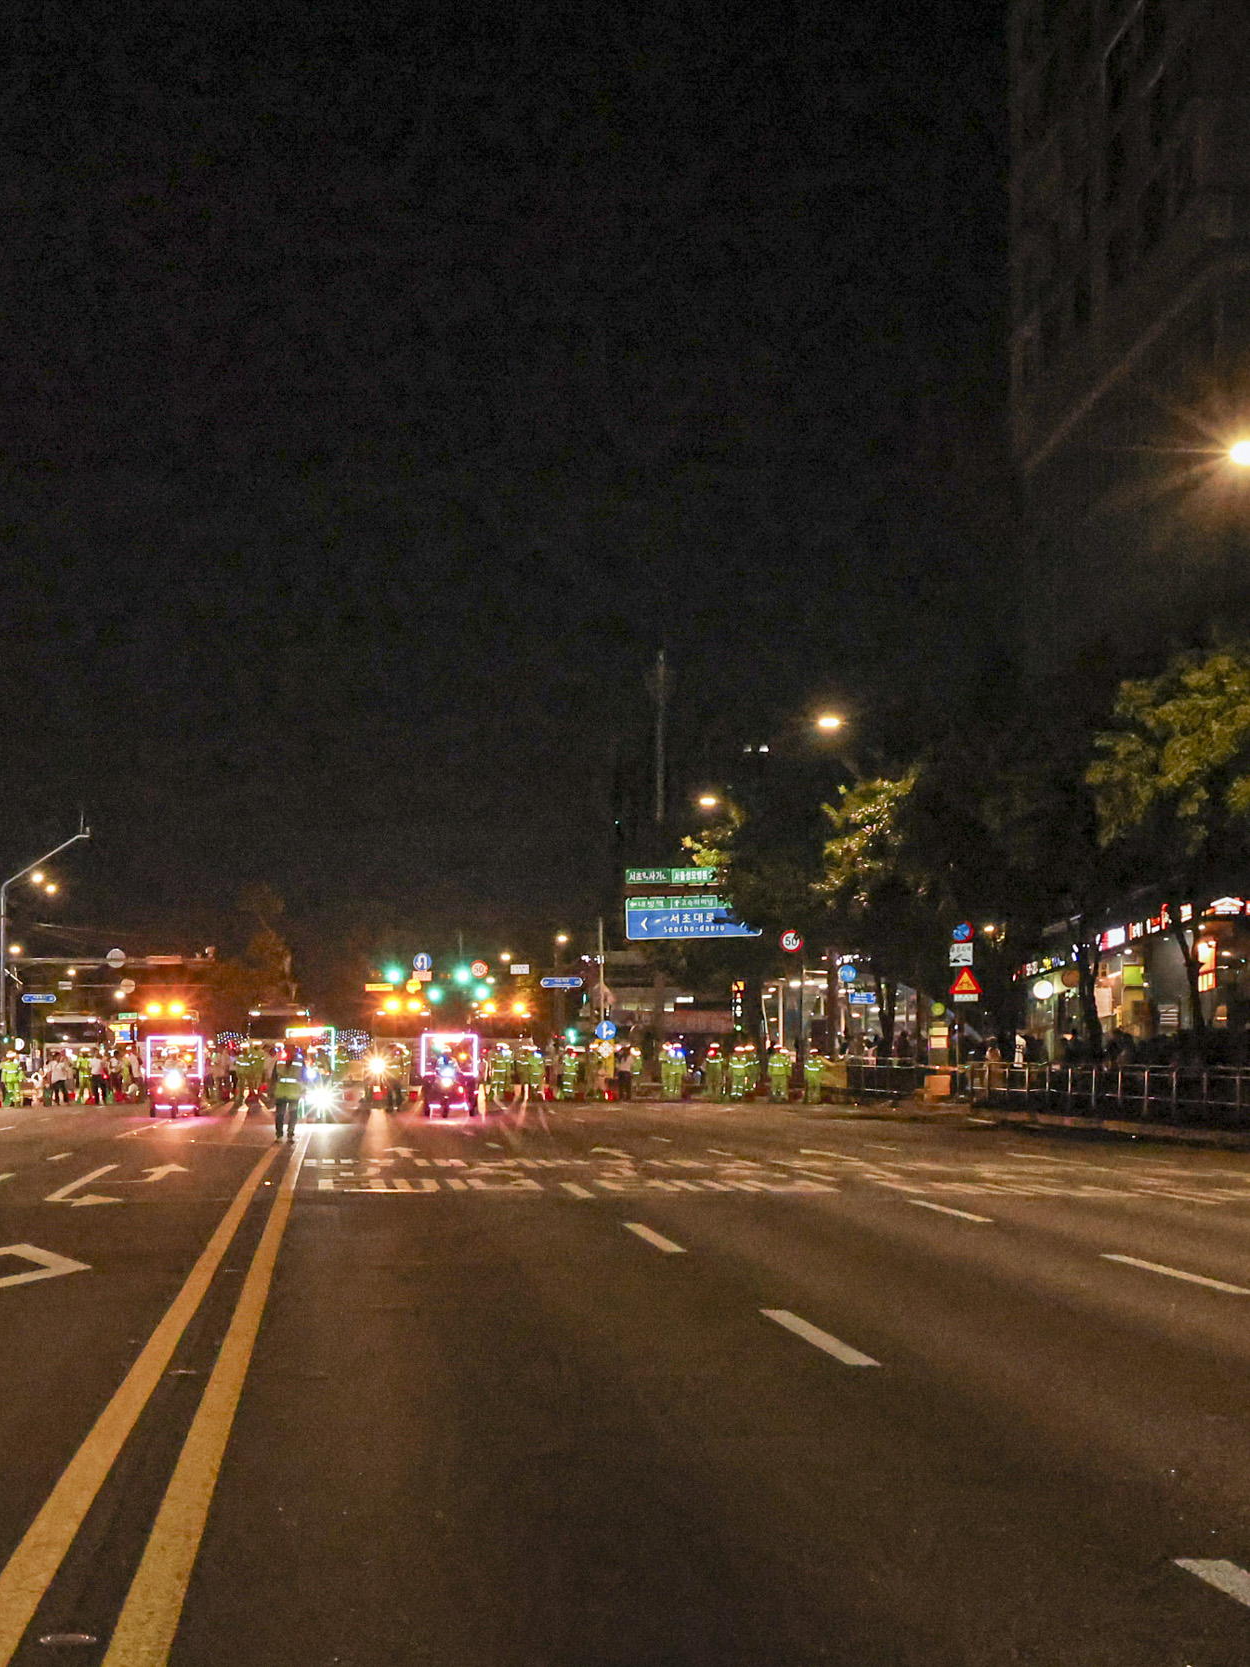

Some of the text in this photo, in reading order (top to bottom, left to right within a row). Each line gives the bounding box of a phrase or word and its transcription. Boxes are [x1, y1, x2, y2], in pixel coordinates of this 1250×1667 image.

[670, 912, 715, 924] 서초대로
[663, 925, 725, 933] Seocho-daero
[785, 936, 798, 947] 50
[474, 964, 484, 974] 50
